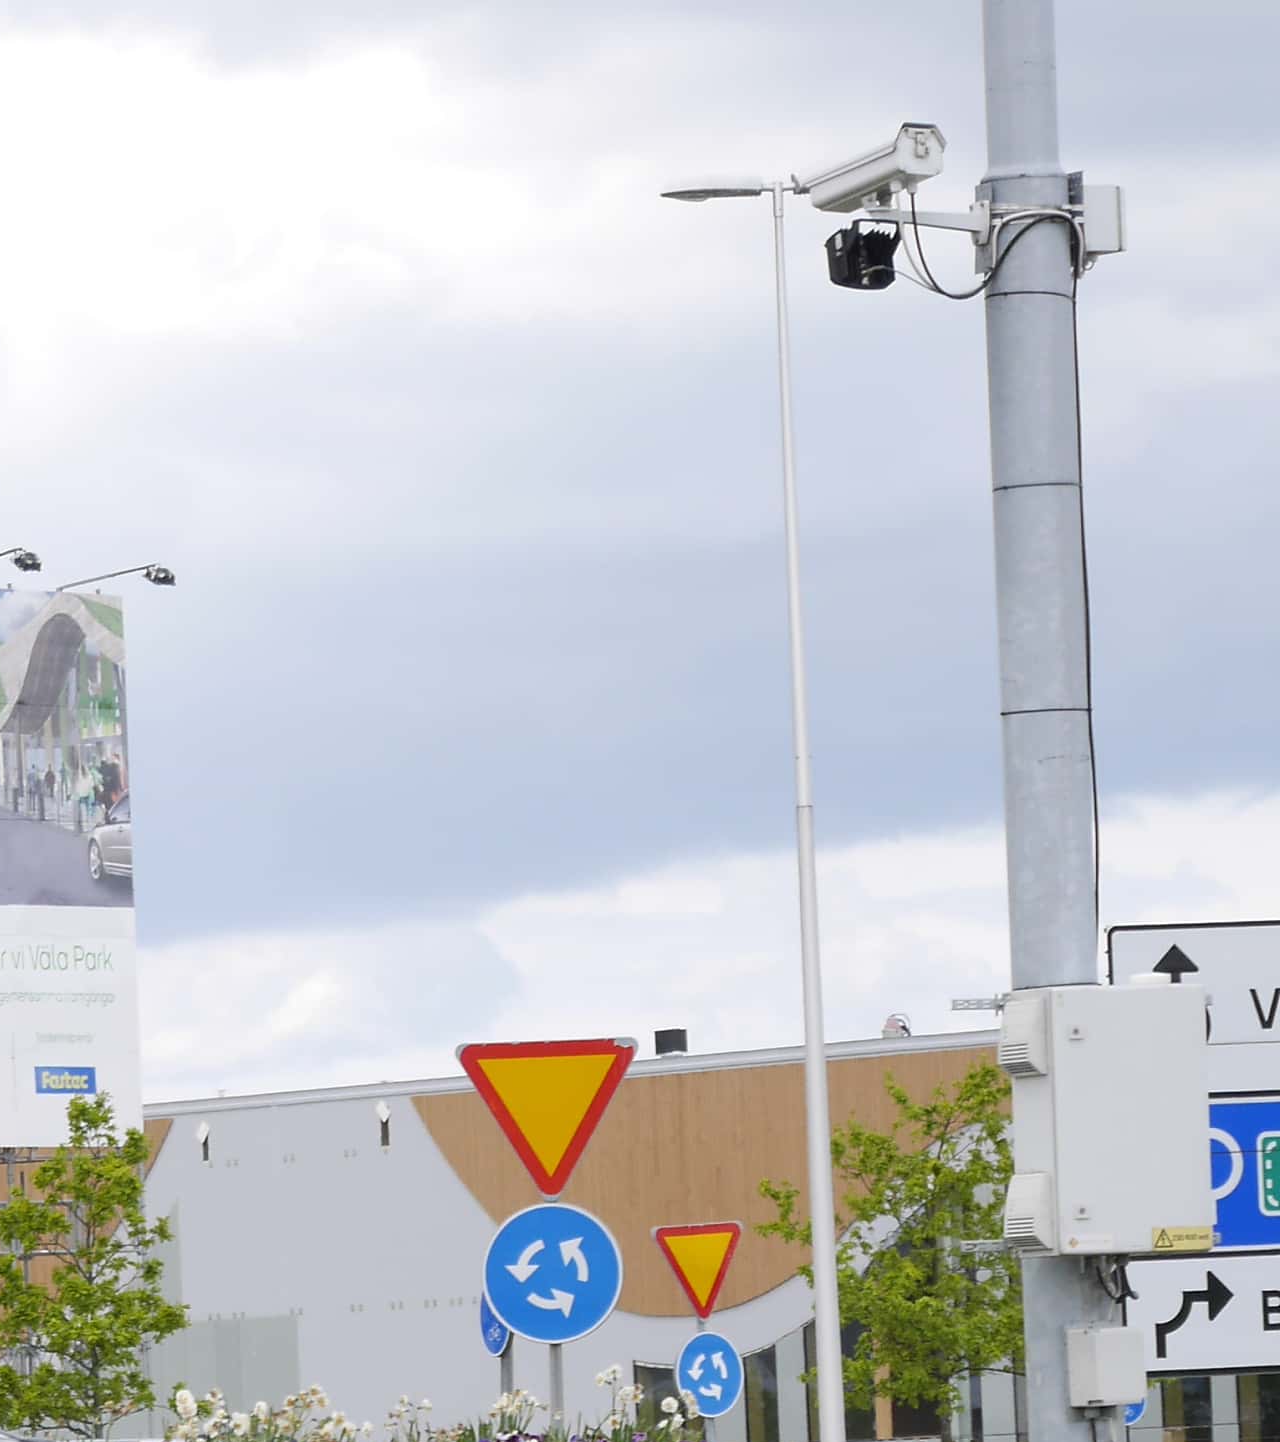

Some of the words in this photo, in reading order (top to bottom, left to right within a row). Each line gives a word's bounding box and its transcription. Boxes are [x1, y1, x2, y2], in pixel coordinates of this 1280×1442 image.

[11, 946, 25, 969] vi
[28, 943, 69, 971] Väla
[73, 944, 115, 971] Park
